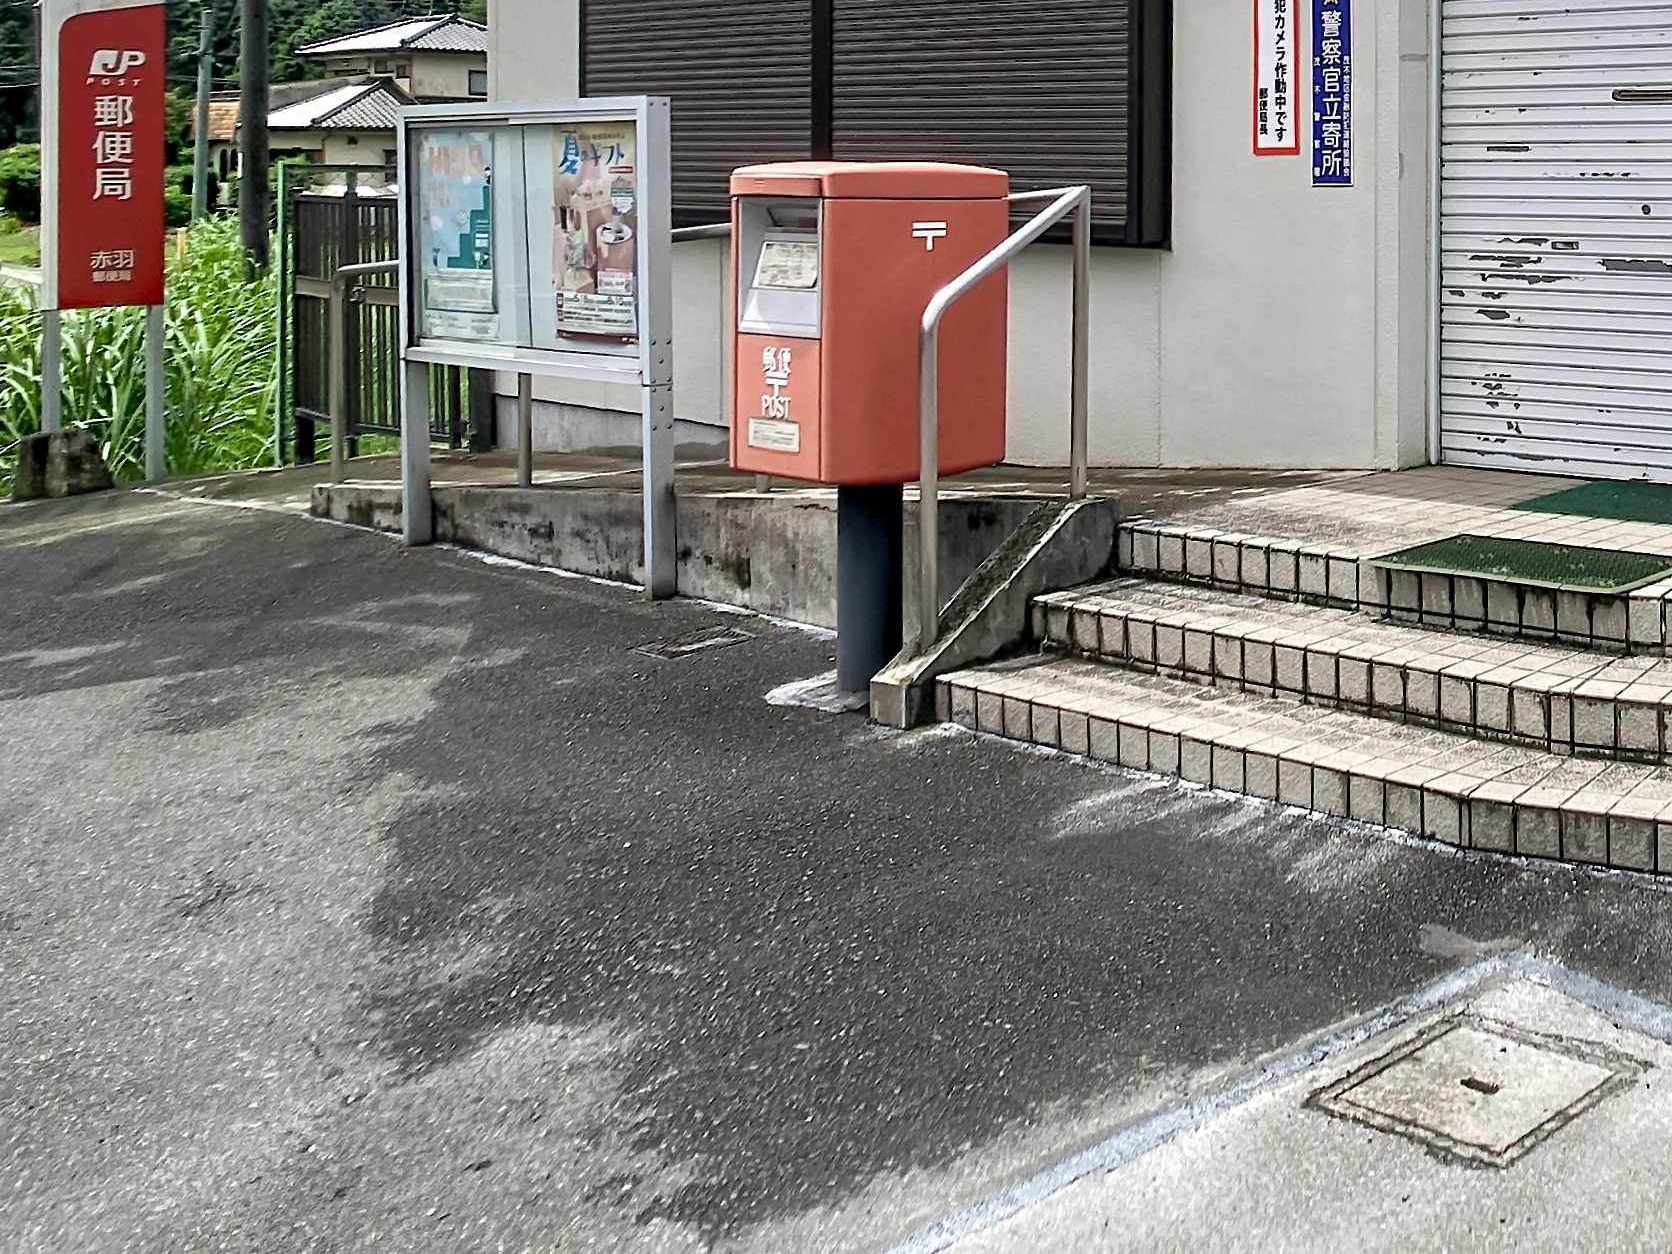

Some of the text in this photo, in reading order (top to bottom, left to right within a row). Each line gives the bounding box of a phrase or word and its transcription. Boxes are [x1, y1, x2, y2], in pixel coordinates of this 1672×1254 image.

[86, 77, 144, 87] POST
[1321, 10, 1343, 177] 警察官立寄所
[92, 95, 134, 200] 郵便局
[90, 249, 134, 269] 赤羽
[762, 346, 792, 374] 郵便
[761, 395, 792, 419] POST
